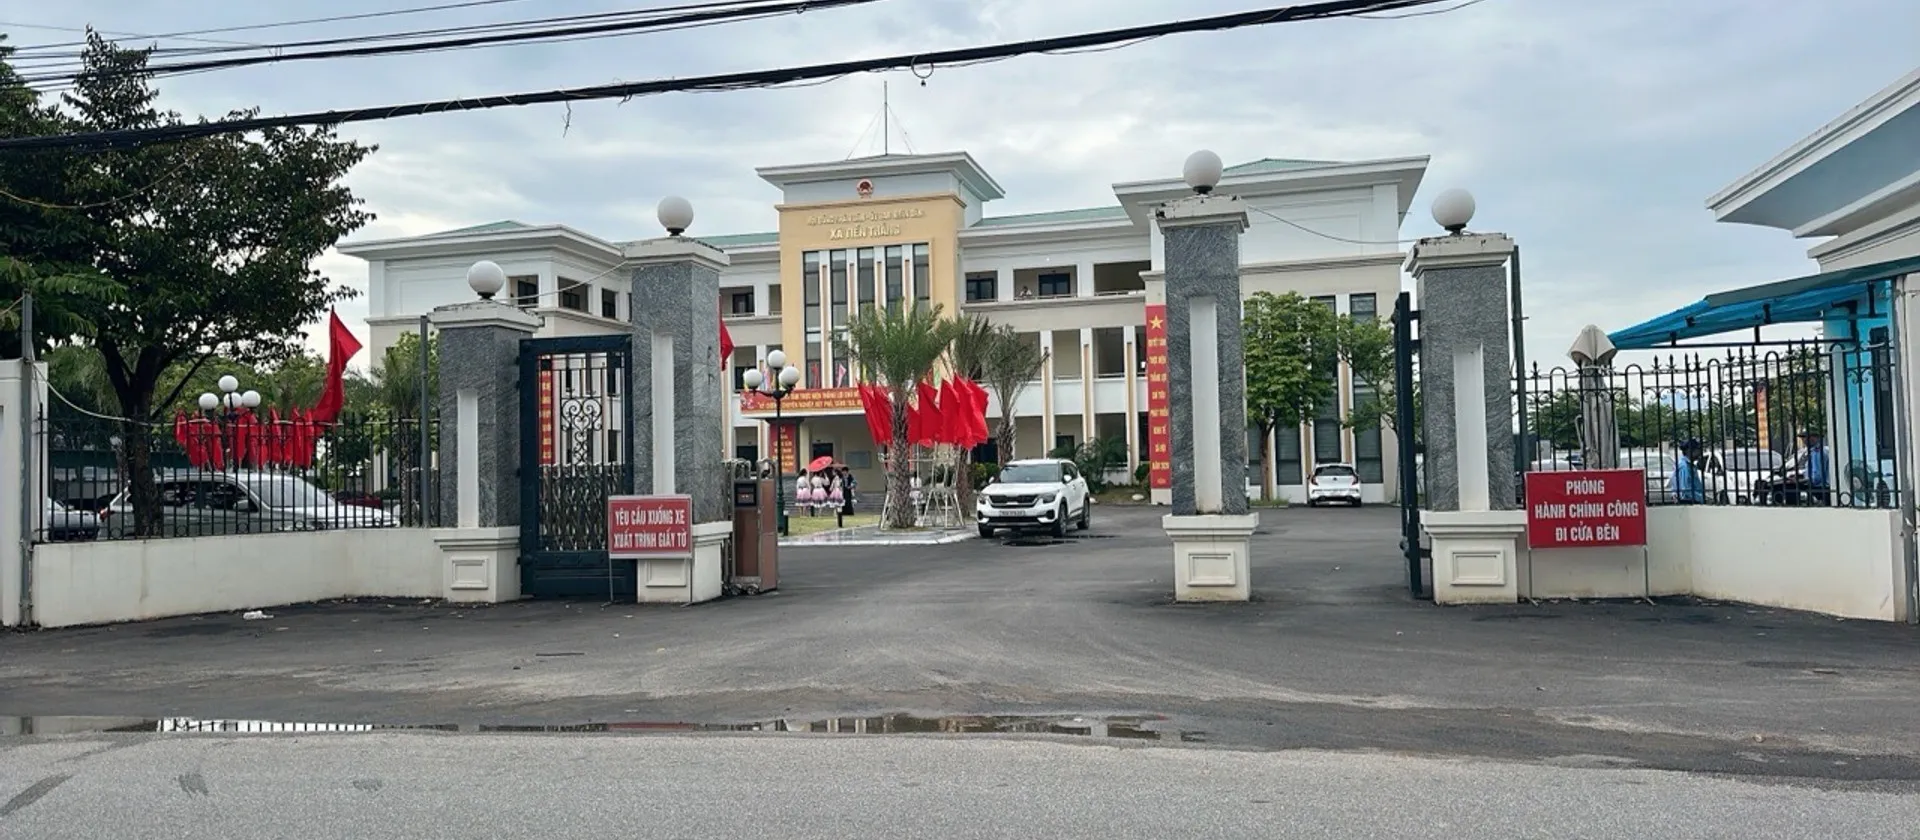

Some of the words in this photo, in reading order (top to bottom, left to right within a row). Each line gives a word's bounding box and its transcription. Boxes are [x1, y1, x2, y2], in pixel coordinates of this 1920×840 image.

[1566, 477, 1605, 496] PHÒNG
[615, 507, 630, 526] YÊU
[648, 504, 673, 525] XUỐNG
[675, 509, 686, 525] XE
[1535, 501, 1566, 519] HÀNH
[1569, 500, 1604, 518] CHÍNH
[1607, 499, 1639, 517] CÔNG
[614, 527, 633, 548] XUẤT
[634, 529, 657, 548] TRÌNH
[658, 526, 676, 548] GIẤY
[676, 528, 687, 548] TỜ
[1555, 527, 1567, 542] ĐI
[1570, 520, 1593, 541] CỬA
[1596, 523, 1620, 541] BÊN
